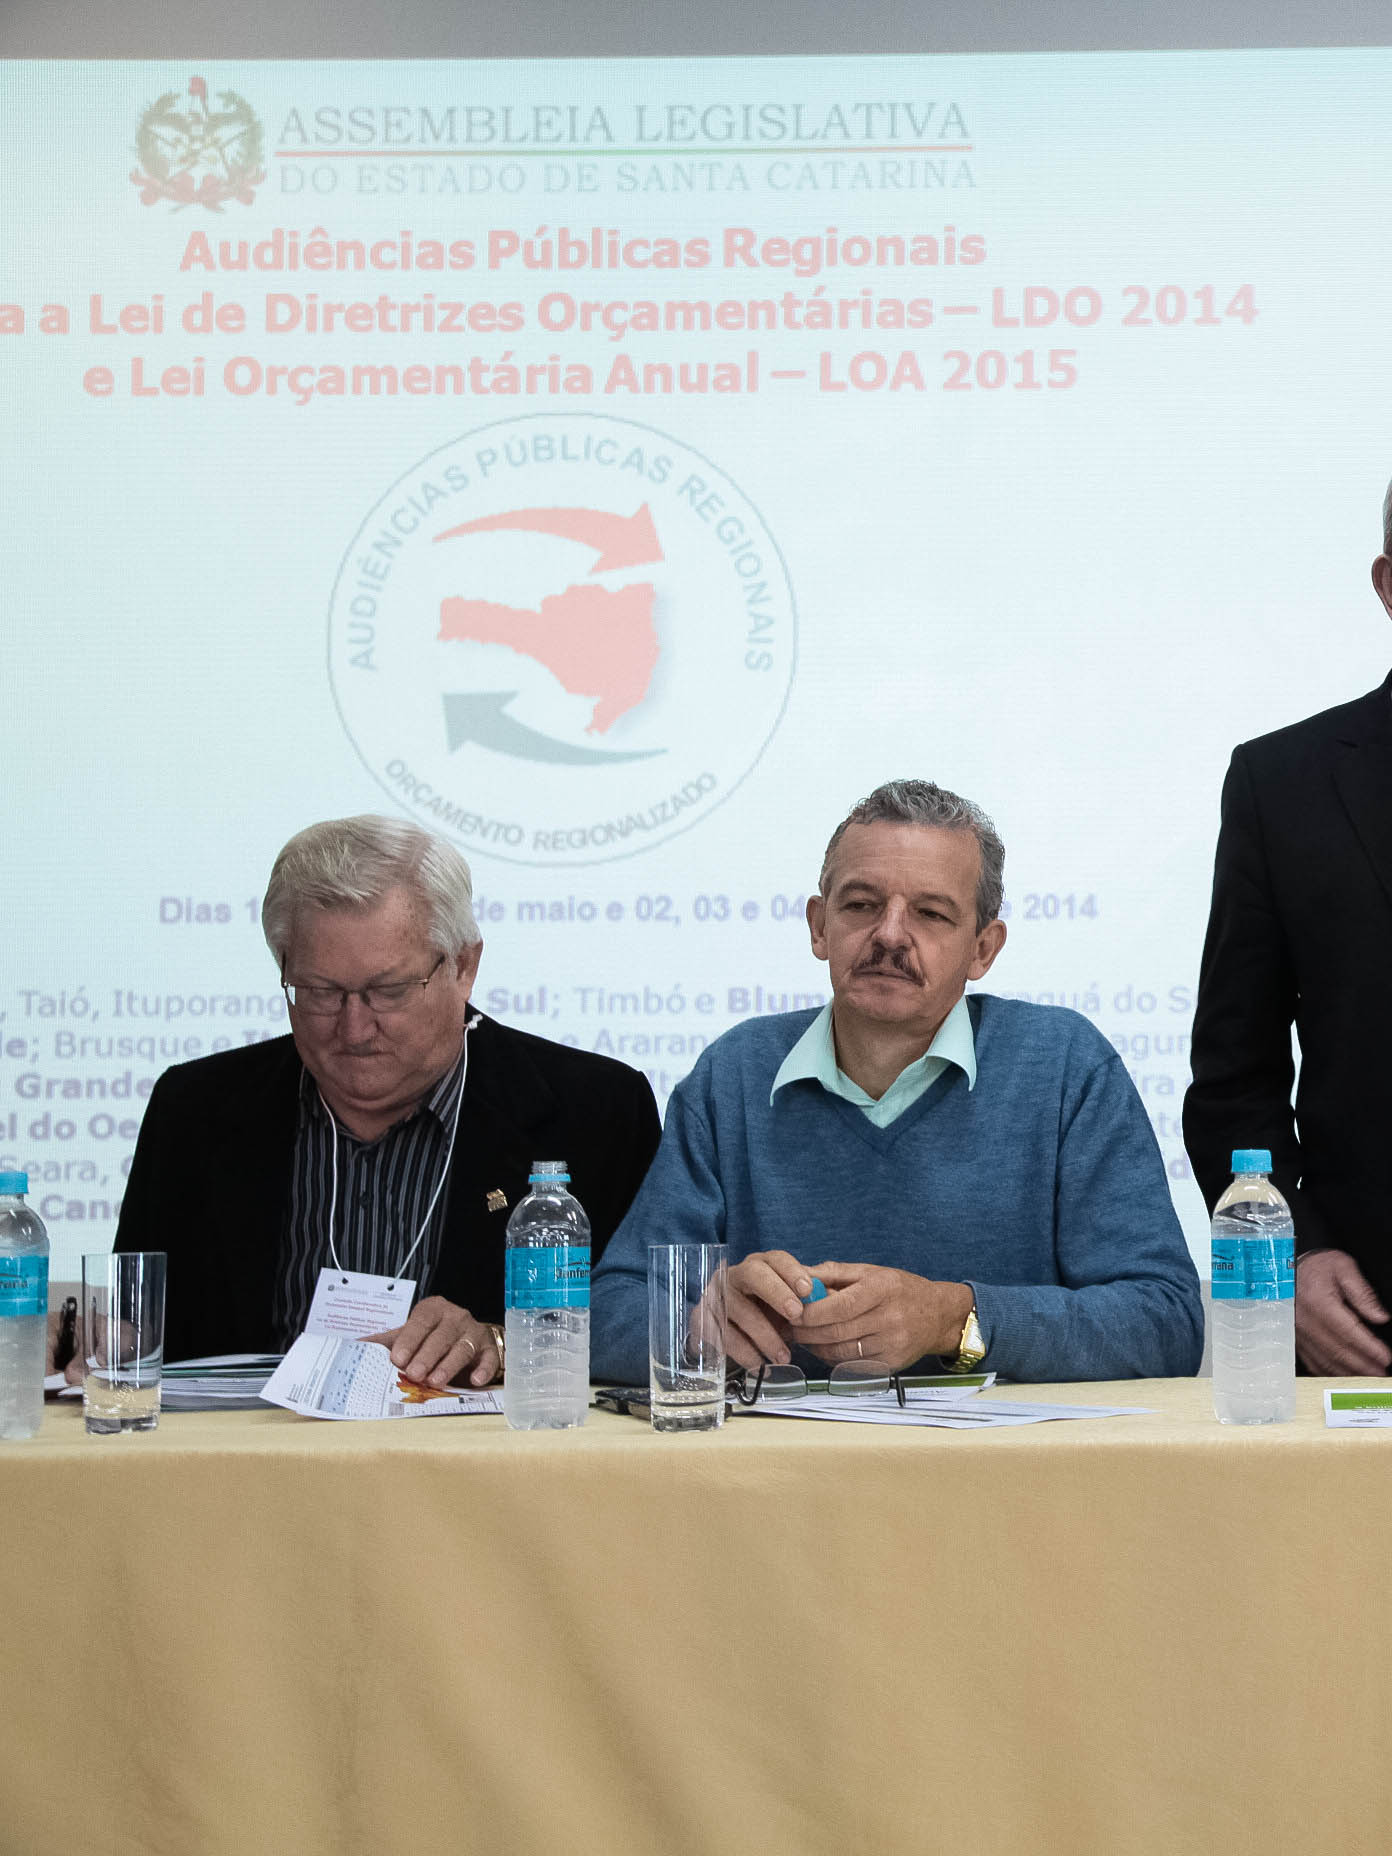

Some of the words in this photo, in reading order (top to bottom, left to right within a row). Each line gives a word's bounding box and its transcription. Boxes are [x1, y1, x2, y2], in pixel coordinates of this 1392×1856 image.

[278, 105, 614, 145] ASSEMBLEIA
[635, 102, 972, 143] LEGISLATIVA
[279, 164, 338, 194] DO
[355, 163, 526, 194] ESTADO
[543, 162, 601, 193] DE
[616, 161, 750, 193] SANTA
[766, 159, 978, 191] CATARINA
[180, 226, 474, 271] Audiências
[488, 225, 710, 269] Públicas
[723, 225, 986, 278] Regionais
[40, 304, 70, 334] a
[90, 293, 164, 335] Lei
[182, 291, 246, 334] de
[265, 292, 525, 334] Diretrizes
[538, 285, 933, 342] Orçamentárias
[992, 286, 1103, 328] LDO
[1122, 284, 1259, 326] 2014
[83, 366, 114, 397] e
[131, 356, 205, 397] Lei
[223, 350, 593, 406] Orçamentária
[604, 351, 758, 395] Anual
[820, 350, 926, 392] LOA
[943, 348, 1077, 390] 2015
[677, 473, 776, 672] REGIONAIS
[160, 896, 232, 924] Dias
[245, 896, 262, 924] 1
[518, 895, 600, 922] maio
[606, 901, 625, 922] e
[635, 894, 681, 927] 02,
[693, 893, 730, 922] 03
[741, 900, 760, 922] e
[1022, 892, 1100, 921] 2014
[17, 985, 100, 1022] Taió,
[112, 989, 287, 1024] Ituporang
[486, 986, 560, 1019] Sul;
[573, 984, 687, 1015] Timbó
[694, 992, 715, 1014] e
[727, 985, 825, 1014] Blum
[1113, 984, 1158, 1014] do
[55, 1031, 203, 1063] Brusque
[592, 1028, 708, 1057] Araran
[28, 1112, 77, 1141] do
